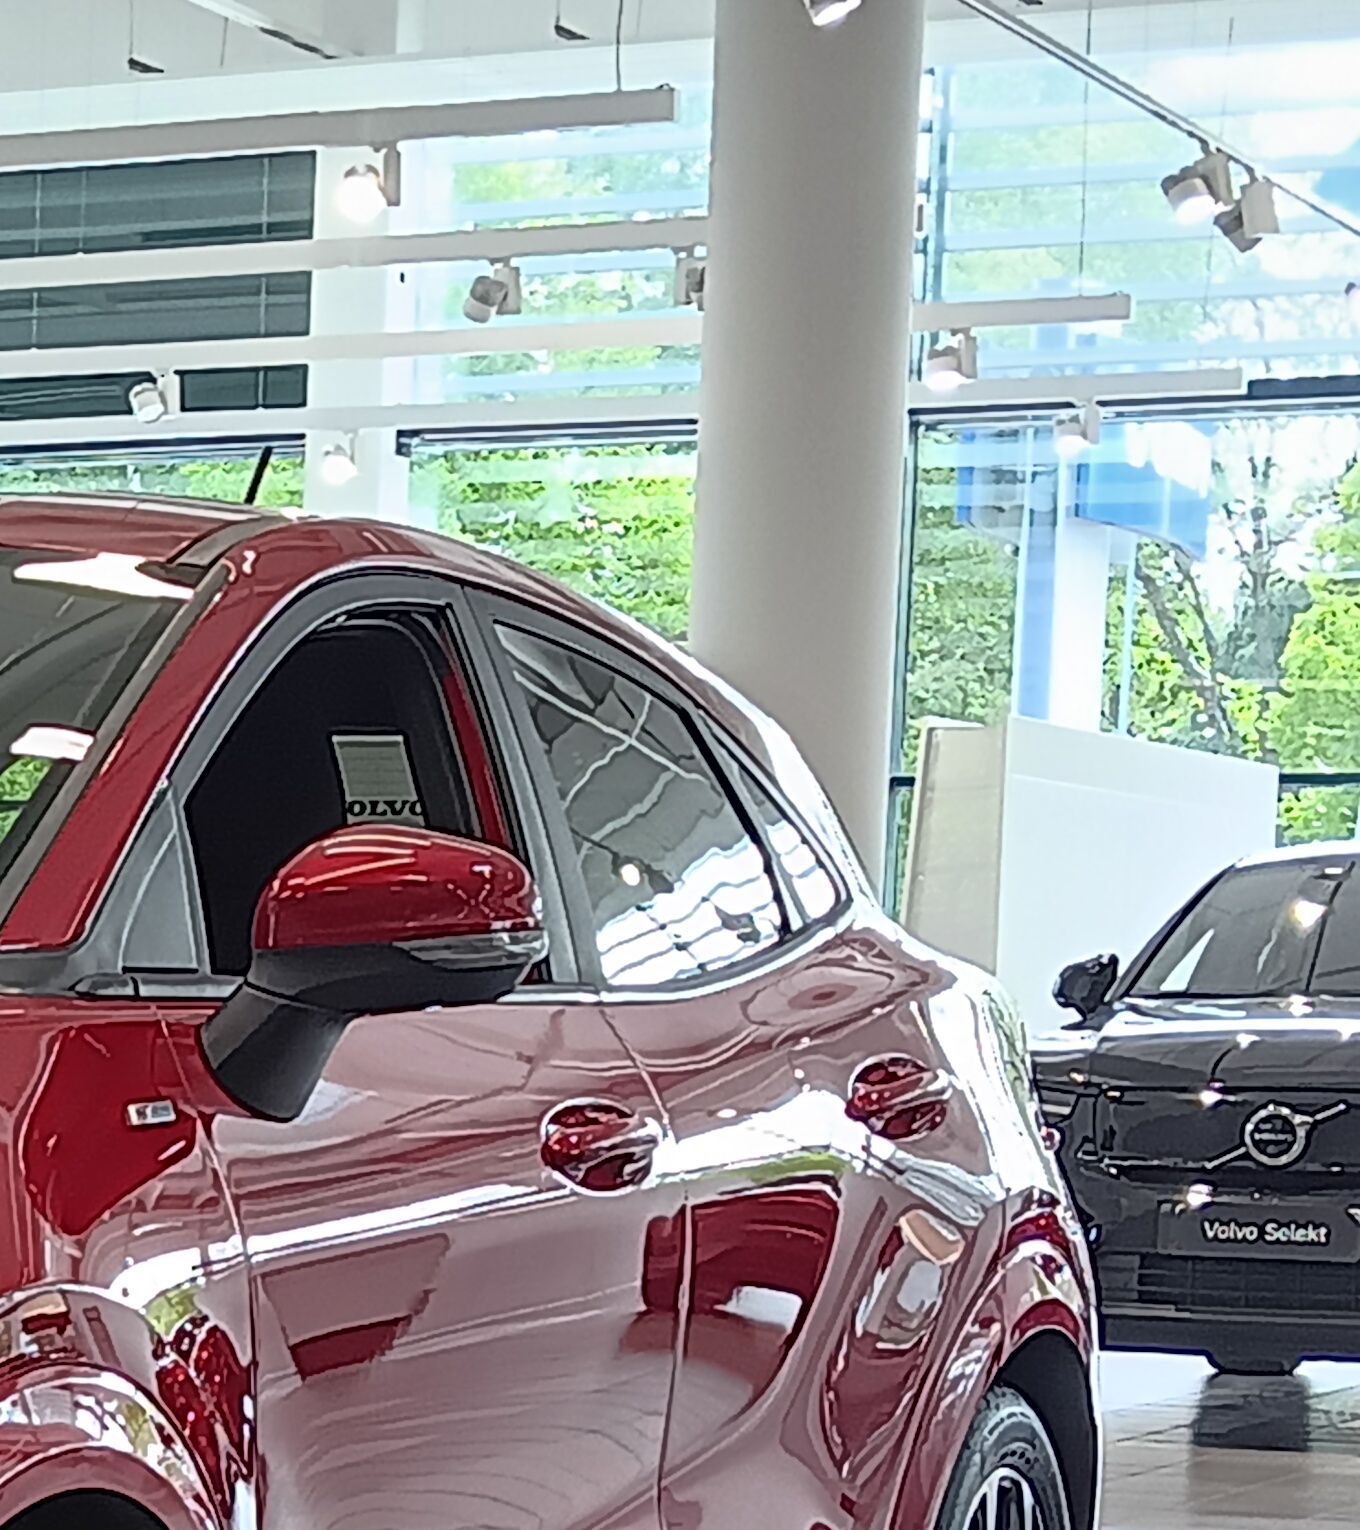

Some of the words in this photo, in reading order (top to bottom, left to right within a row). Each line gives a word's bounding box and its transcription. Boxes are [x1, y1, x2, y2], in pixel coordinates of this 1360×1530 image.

[346, 799, 423, 816] OLVO
[1203, 1220, 1259, 1241] Volvo
[1263, 1222, 1328, 1243] Selekt
